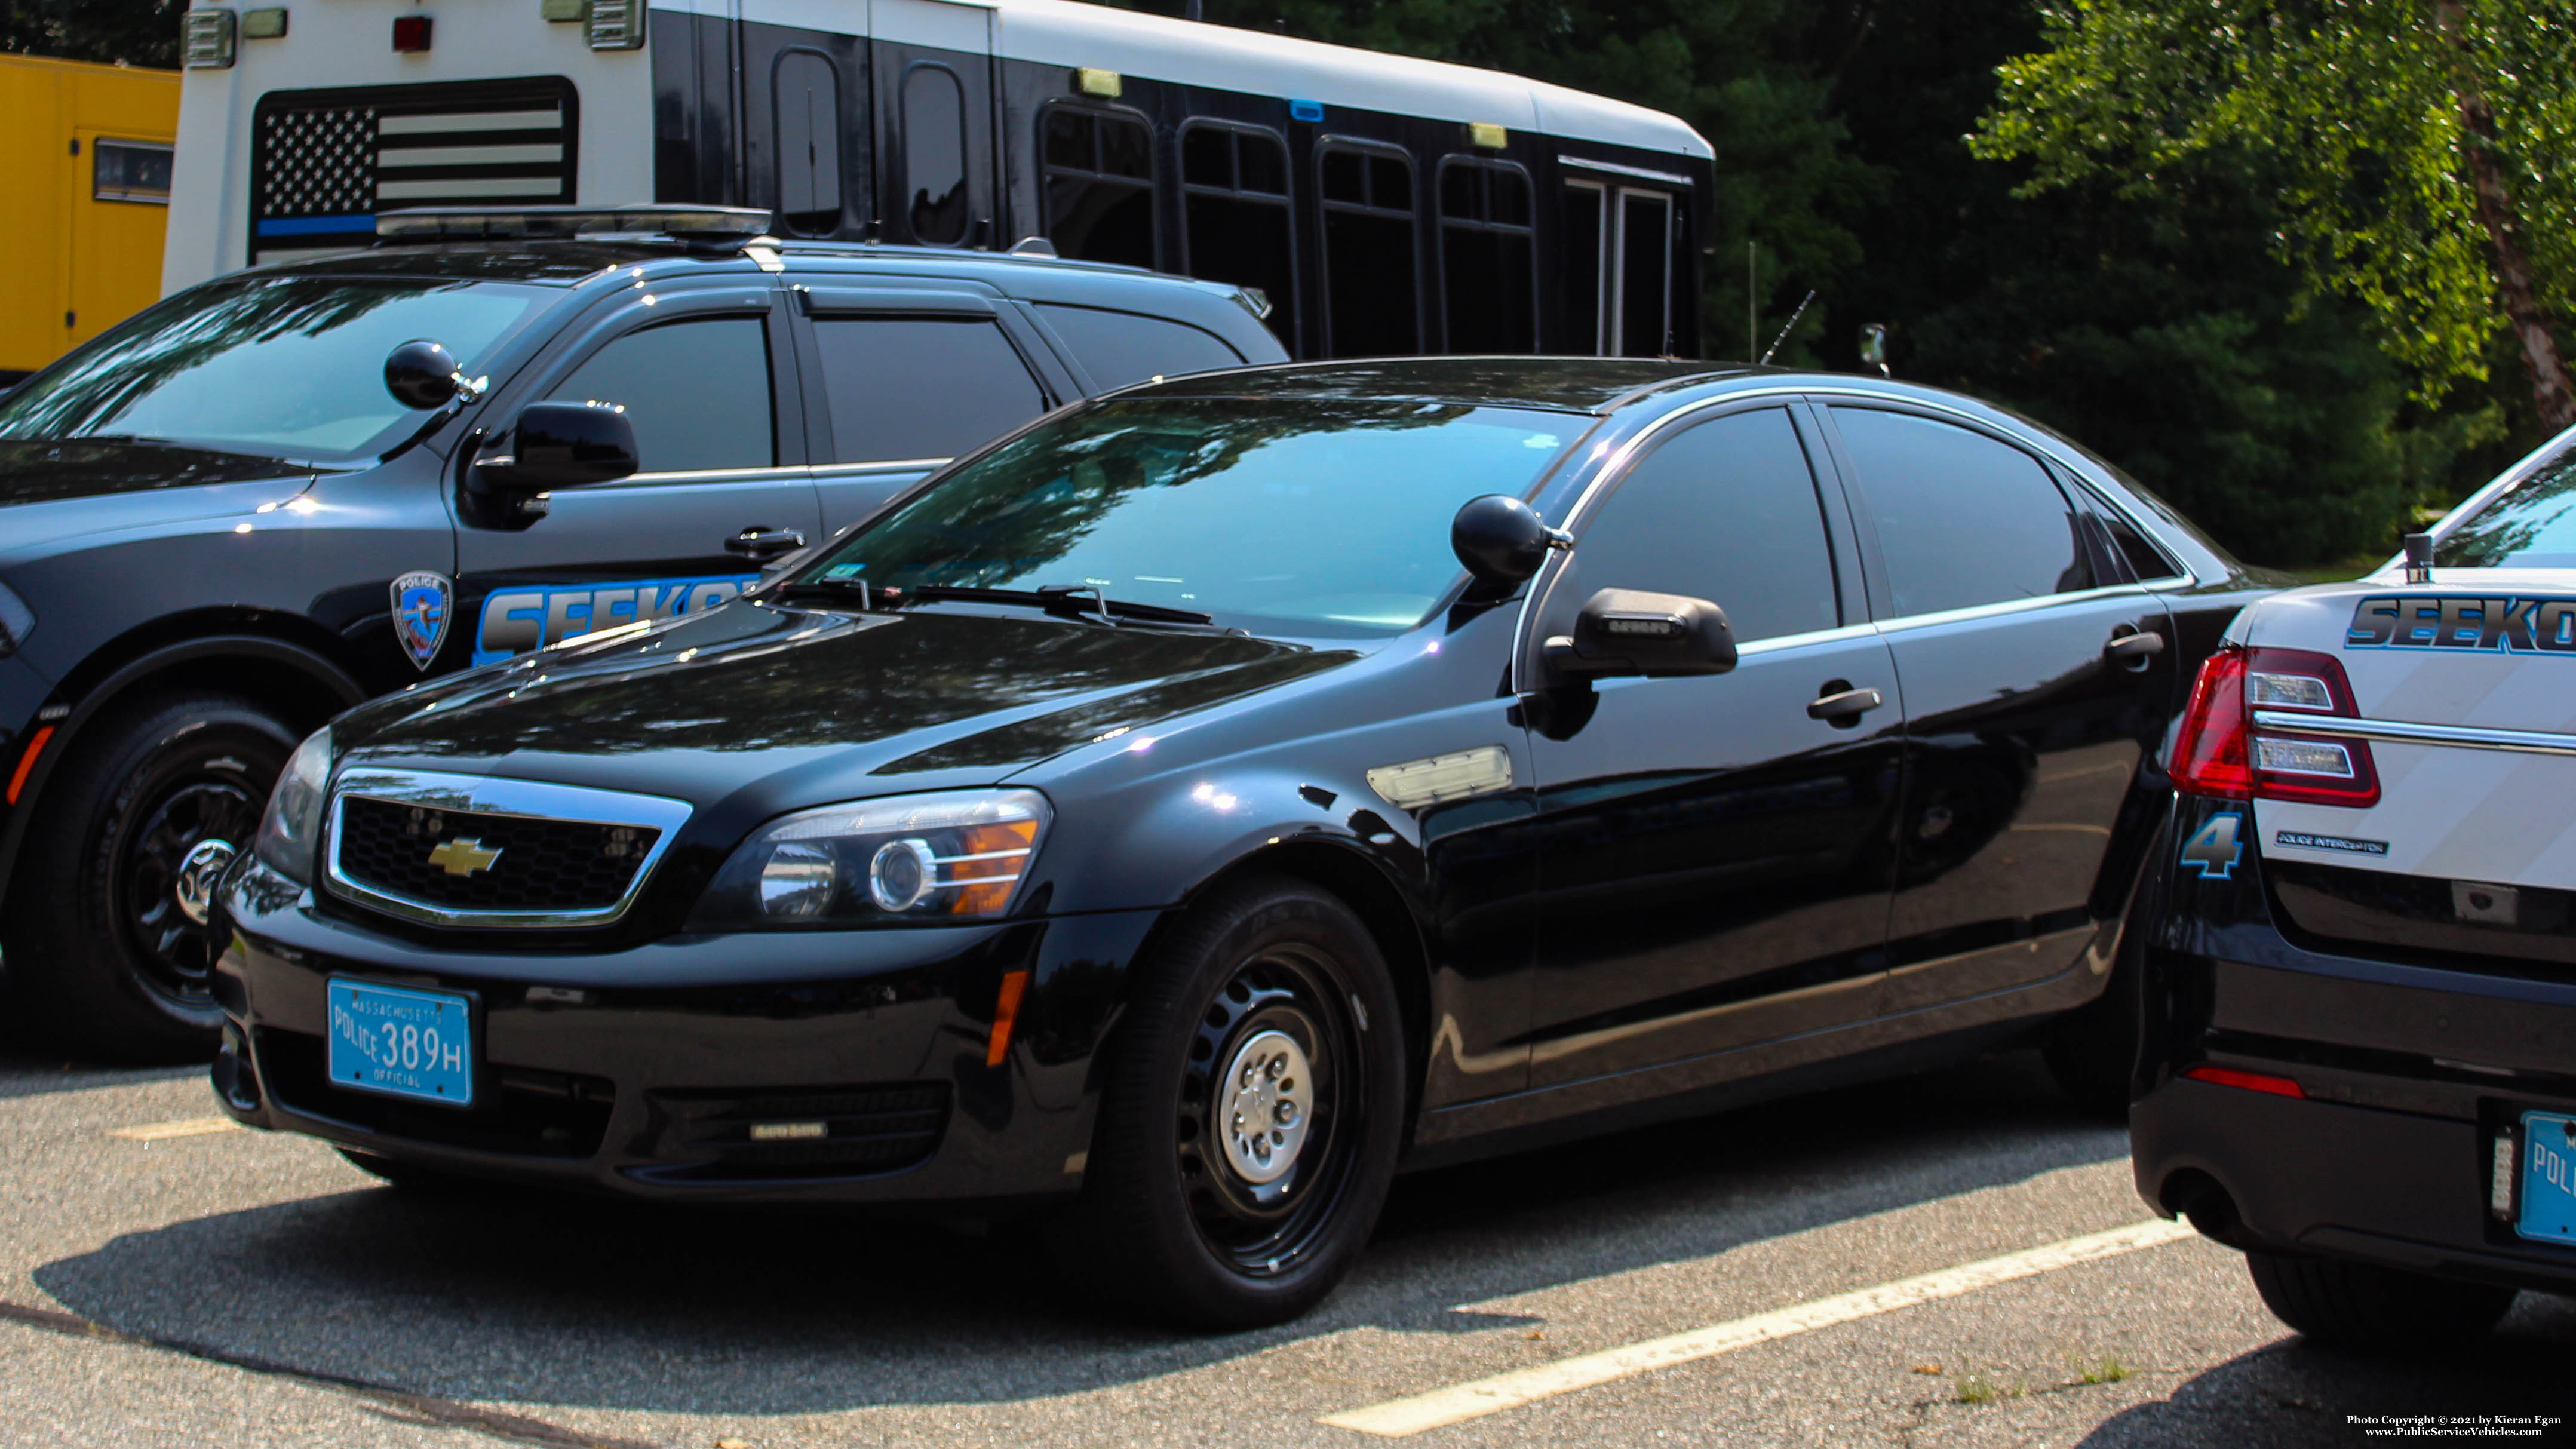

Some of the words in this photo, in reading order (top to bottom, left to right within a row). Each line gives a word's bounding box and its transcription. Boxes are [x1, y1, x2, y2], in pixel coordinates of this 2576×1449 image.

[398, 576, 440, 591] POLICE
[2180, 812, 2243, 879] 4
[352, 999, 442, 1025] MASSACHUSETTS
[334, 1005, 378, 1063] POLICE
[381, 1021, 462, 1073] 389H
[373, 1069, 420, 1088] OFFICIAL
